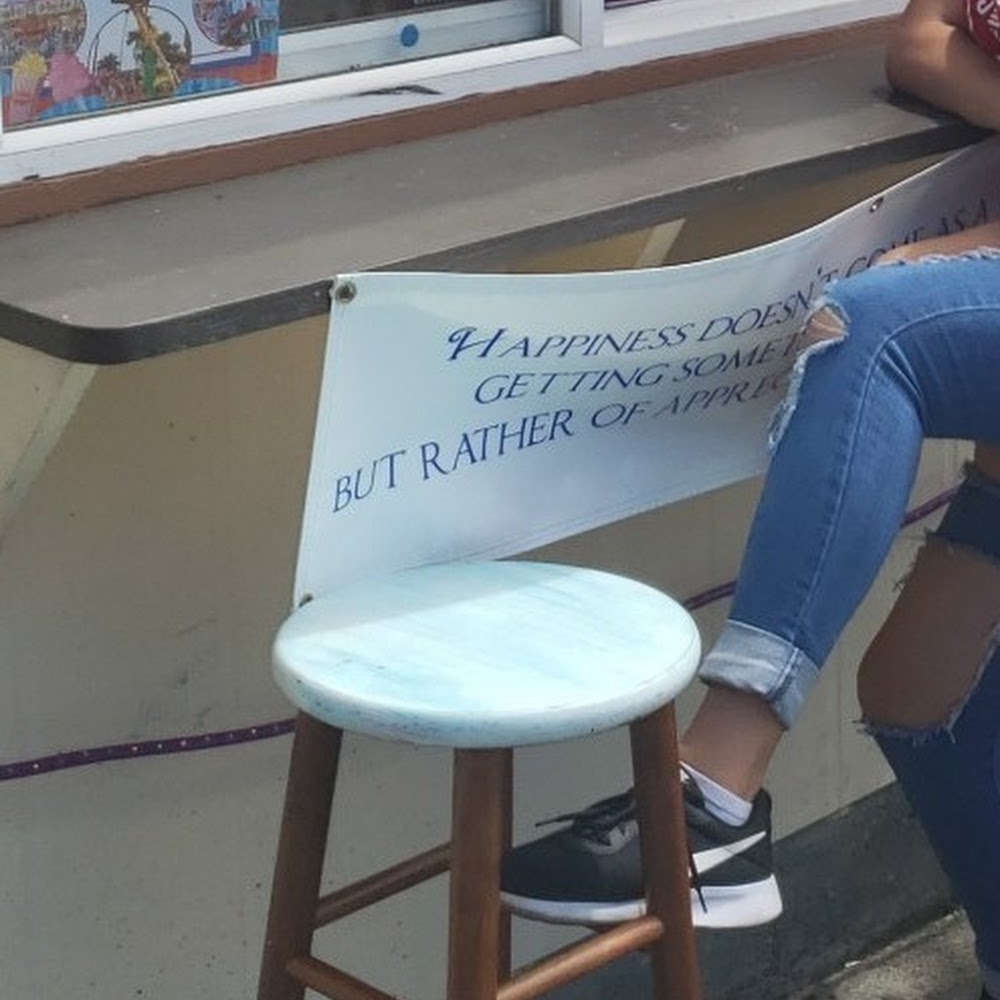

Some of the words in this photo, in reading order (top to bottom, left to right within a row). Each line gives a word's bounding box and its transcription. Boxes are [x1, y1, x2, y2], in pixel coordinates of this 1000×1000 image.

[448, 322, 696, 361] HAPPINESS
[475, 362, 669, 405] GETTING
[672, 328, 807, 384] SOMET
[333, 449, 406, 513] BUT
[420, 409, 574, 480] RATHER
[591, 400, 650, 429] OF
[653, 370, 793, 417] APPREC
